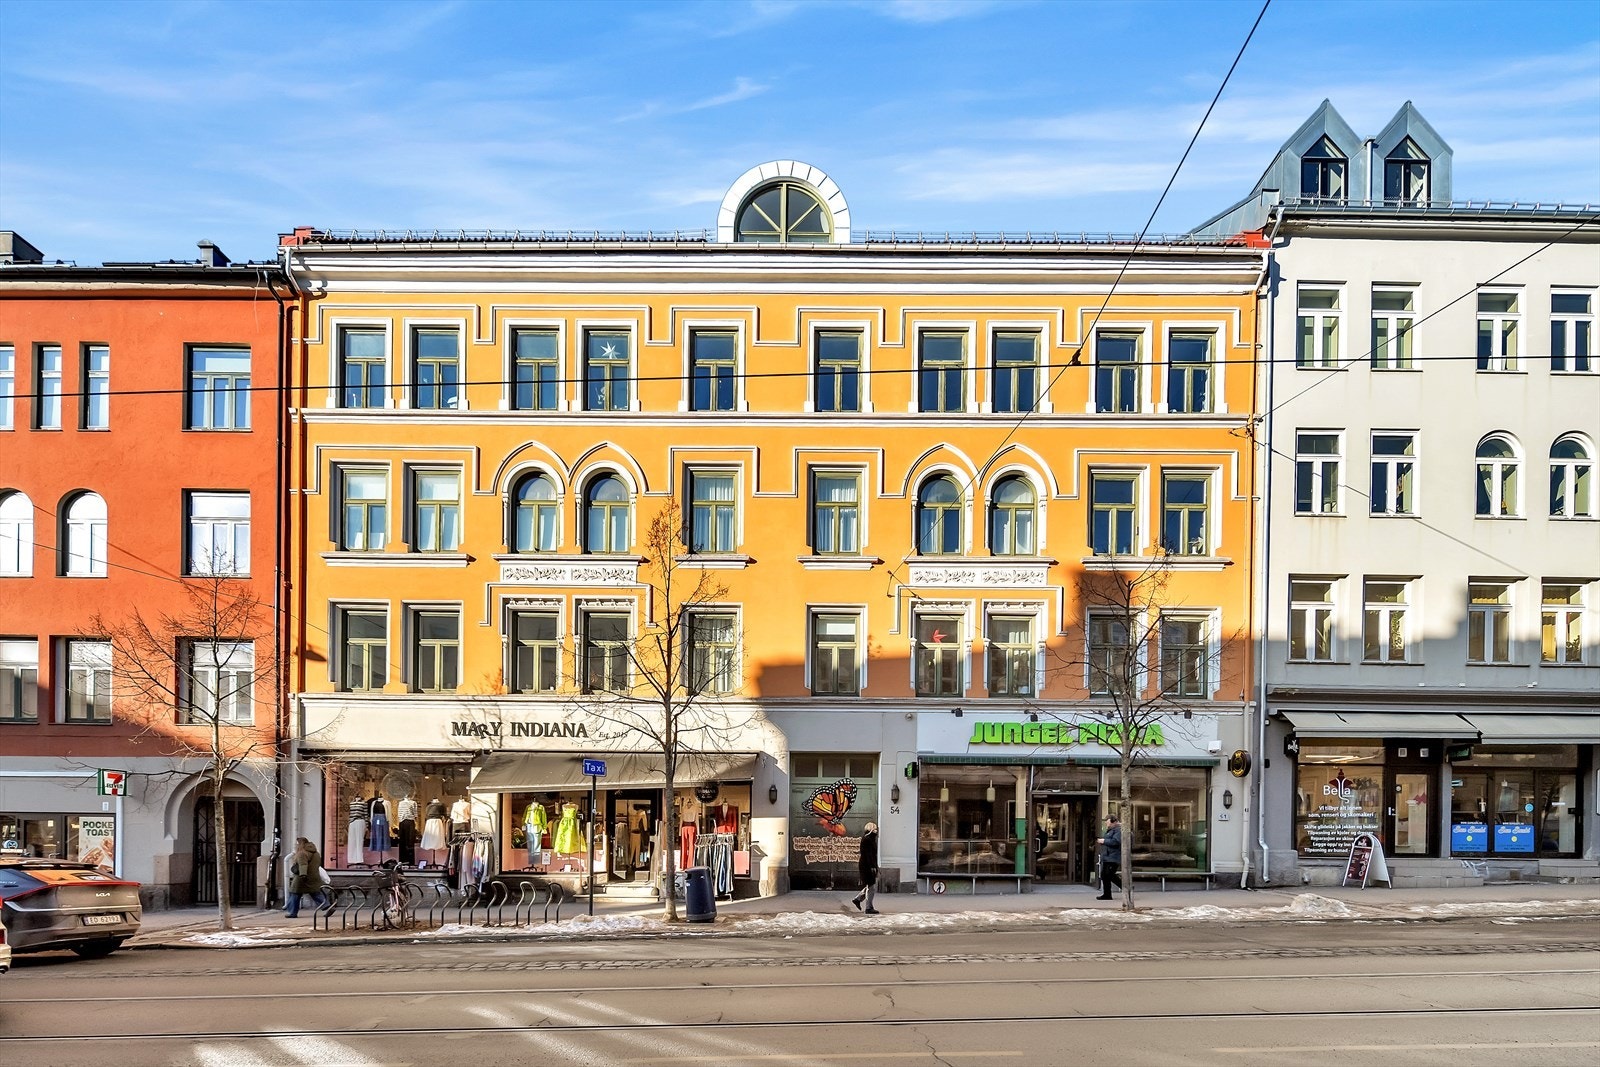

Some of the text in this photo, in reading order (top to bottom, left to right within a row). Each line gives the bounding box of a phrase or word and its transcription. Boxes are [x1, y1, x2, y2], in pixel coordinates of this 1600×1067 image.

[451, 721, 589, 739] MARY INDIANA
[585, 762, 605, 772] Taxi
[1323, 777, 1351, 804] Bella
[890, 805, 900, 815] 54
[82, 821, 114, 829] POCKE
